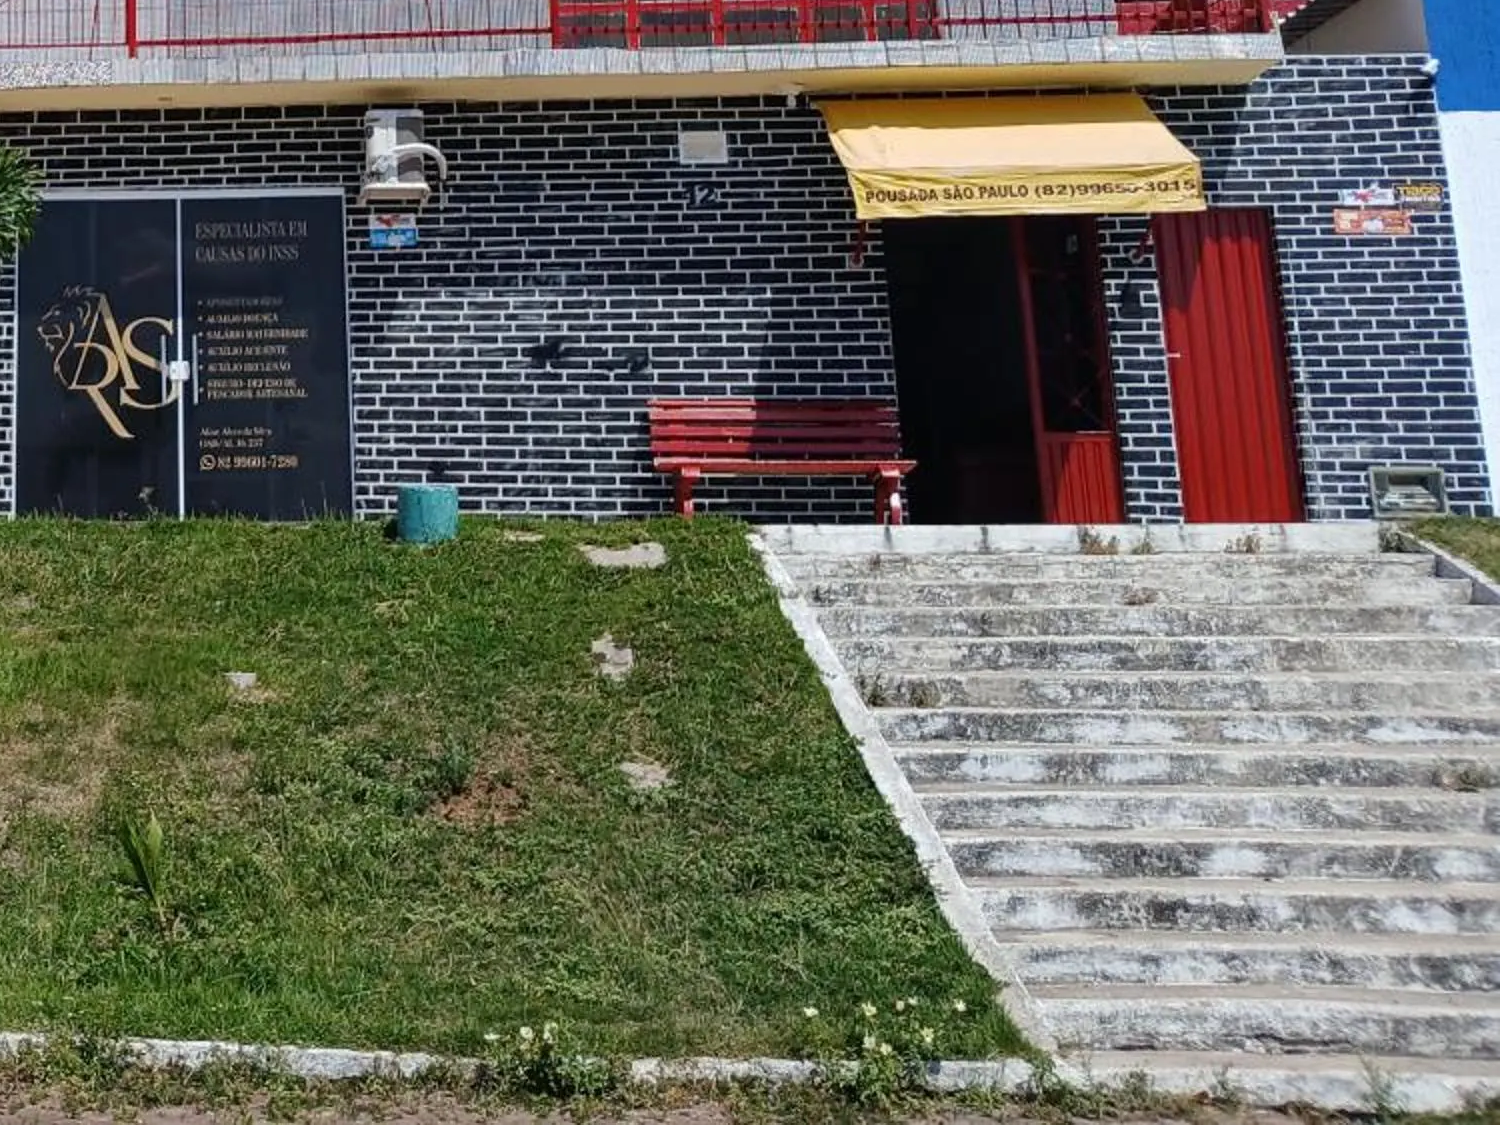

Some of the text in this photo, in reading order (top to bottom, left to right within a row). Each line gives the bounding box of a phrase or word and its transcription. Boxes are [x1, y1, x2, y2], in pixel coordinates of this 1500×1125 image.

[865, 188, 939, 203] POUSADA
[943, 185, 975, 200] SÃO
[980, 184, 1029, 199] PAULO
